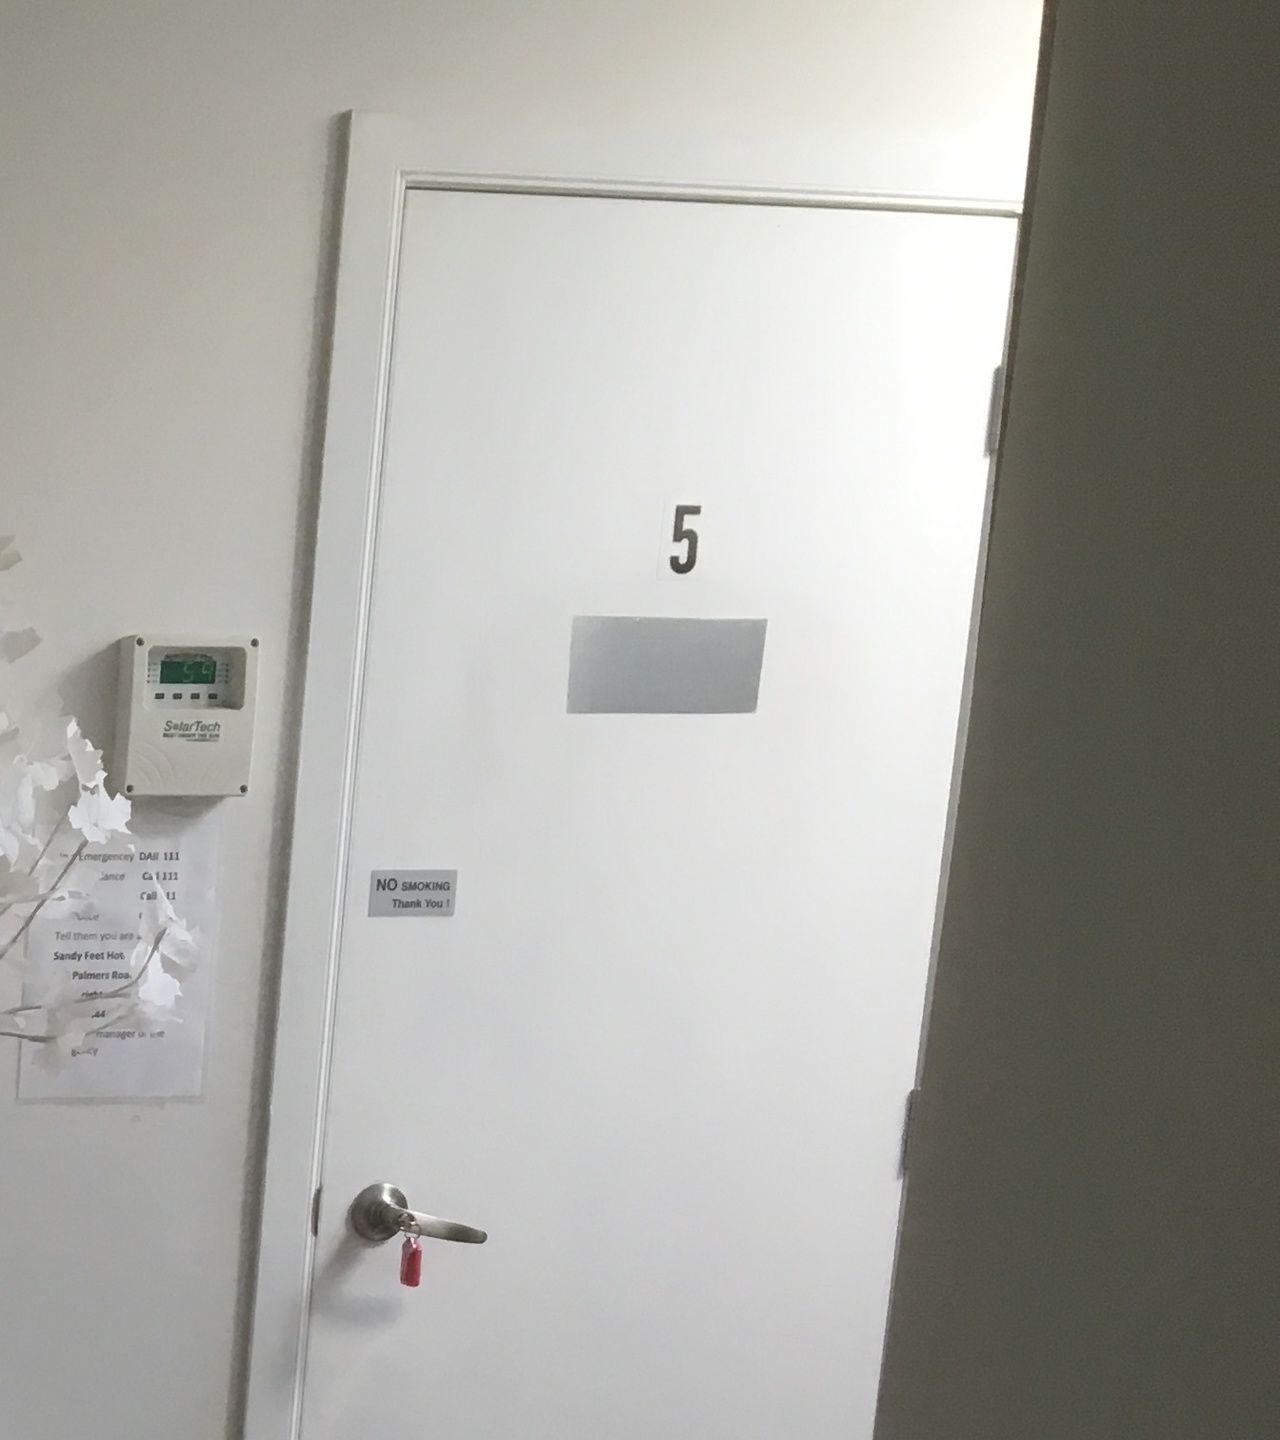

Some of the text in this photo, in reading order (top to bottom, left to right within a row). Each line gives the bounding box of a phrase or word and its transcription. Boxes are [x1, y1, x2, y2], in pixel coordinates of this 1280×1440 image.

[670, 505, 701, 574] 5
[164, 720, 220, 733] SolarTech
[376, 877, 451, 892] NO SMOKING
[392, 898, 422, 909] Thank
[424, 898, 443, 909] You
[53, 951, 83, 962] Sandy
[84, 951, 105, 961] Feet
[71, 970, 110, 981] Palmers
